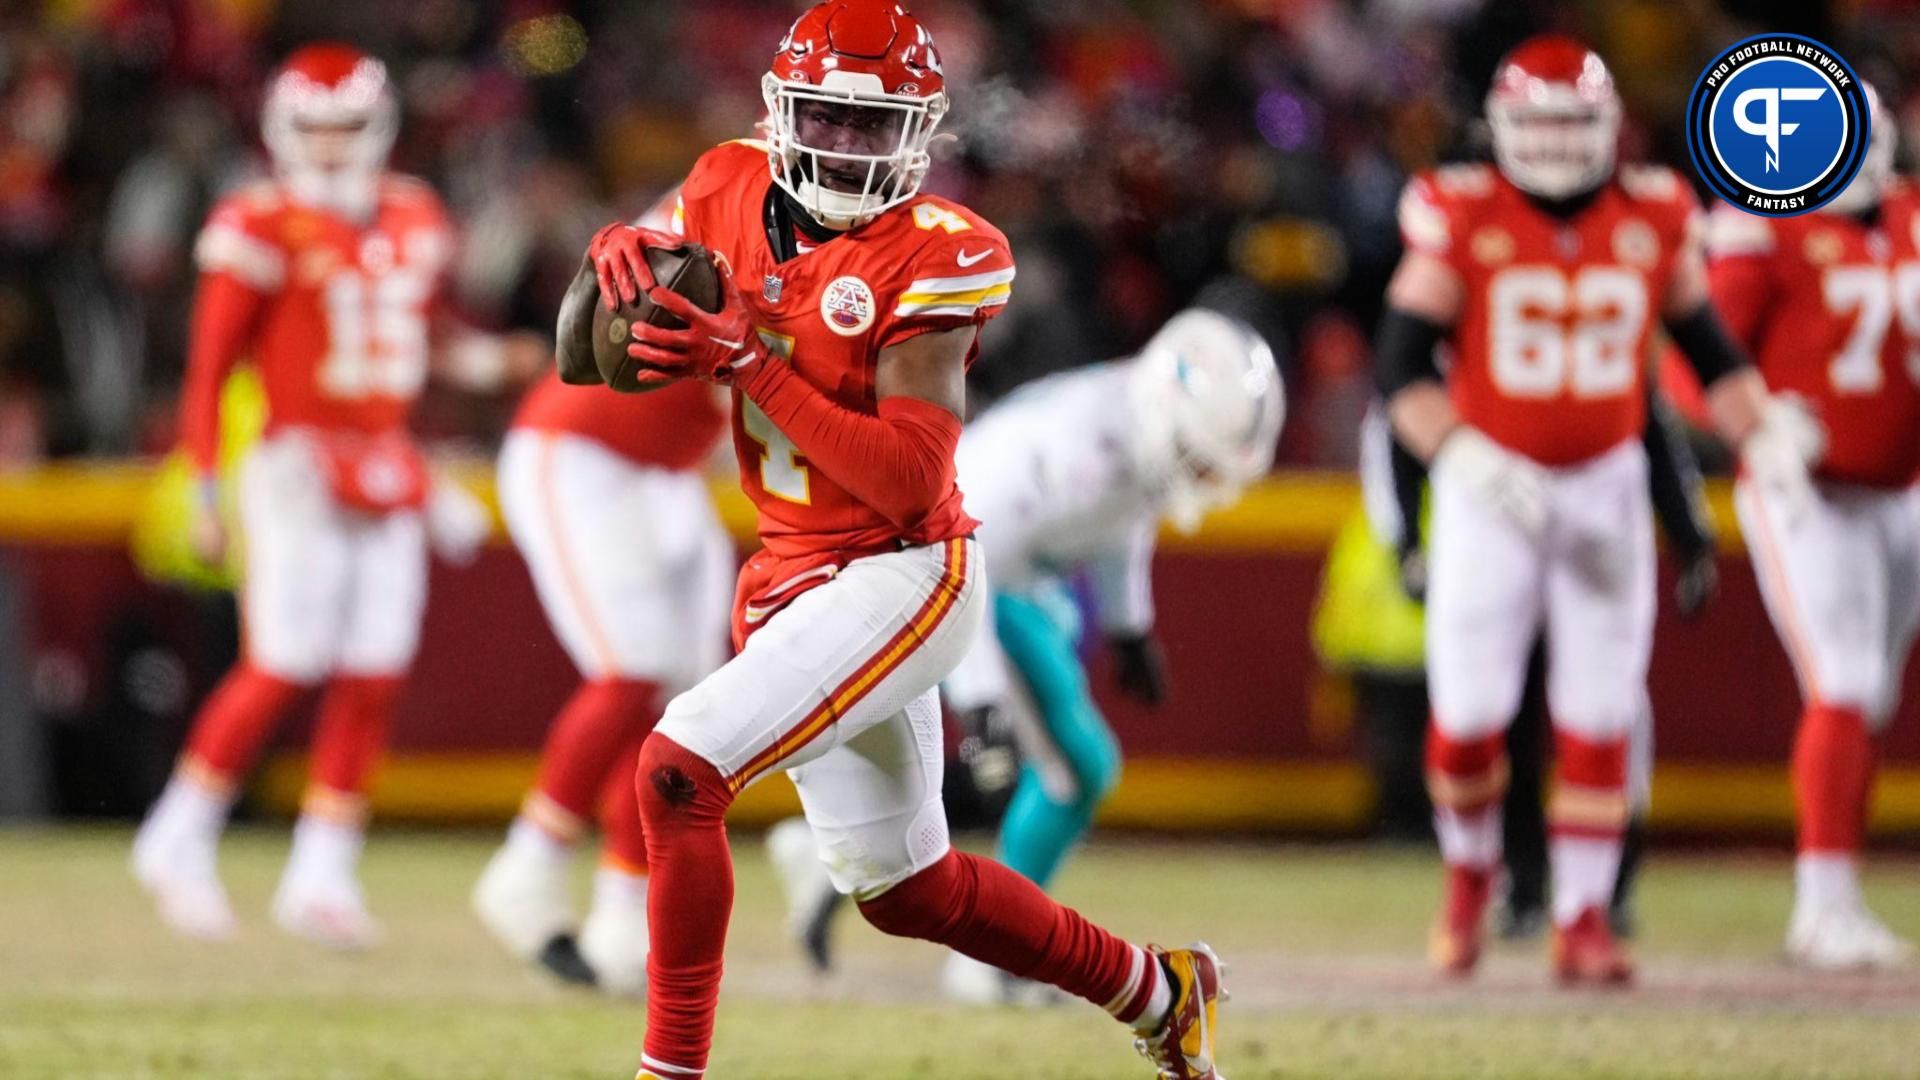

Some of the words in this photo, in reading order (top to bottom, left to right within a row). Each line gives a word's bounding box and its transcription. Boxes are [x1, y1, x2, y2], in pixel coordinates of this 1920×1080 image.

[912, 201, 973, 234] 4
[316, 267, 427, 400] 15
[1487, 266, 1648, 398] 62
